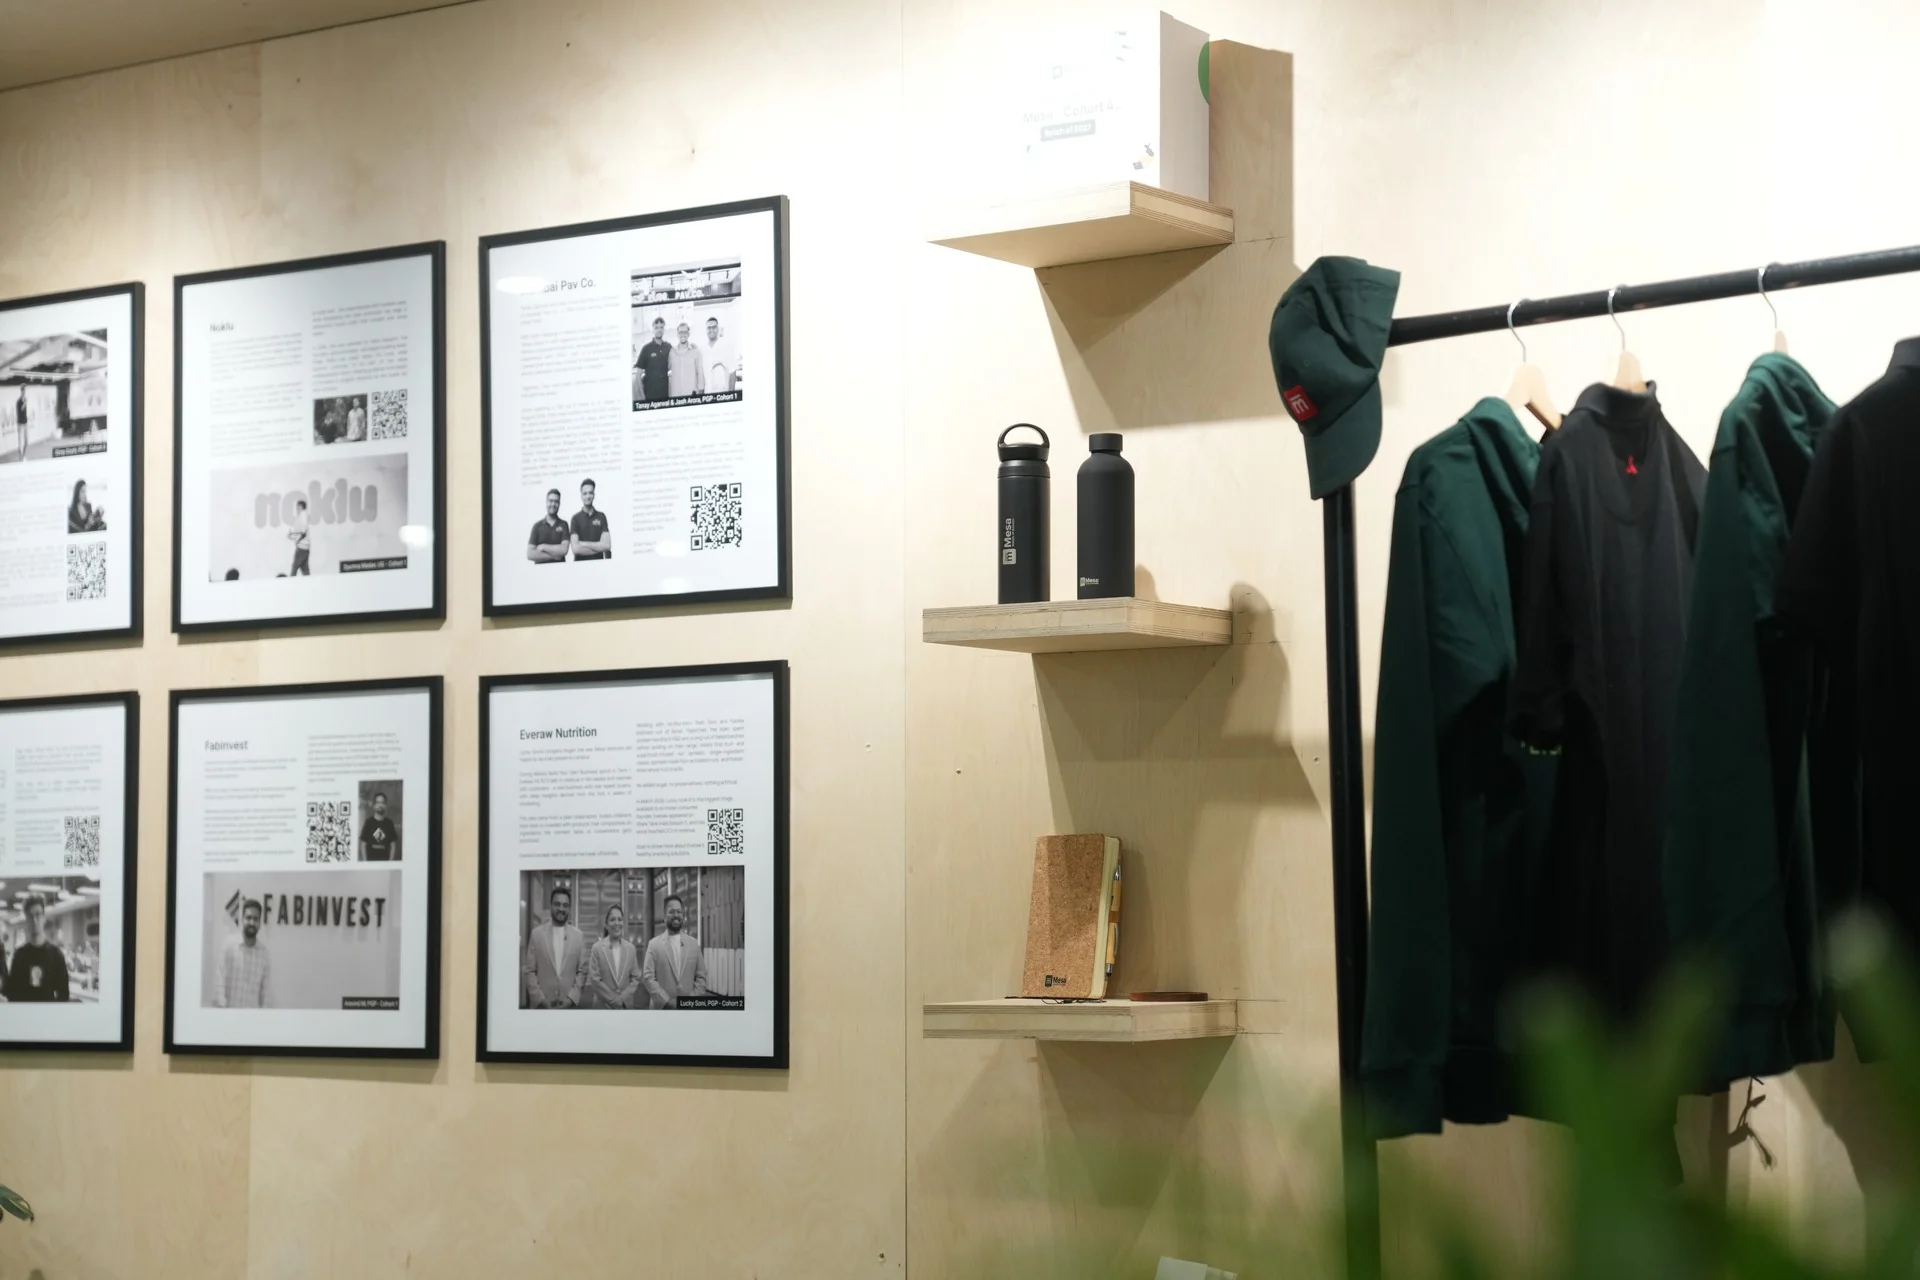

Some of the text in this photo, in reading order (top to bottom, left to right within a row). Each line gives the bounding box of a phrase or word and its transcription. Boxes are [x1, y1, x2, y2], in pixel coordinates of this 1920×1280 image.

[560, 280, 578, 291] Pav
[580, 277, 596, 289] Co.
[717, 393, 734, 401] Cohort
[254, 478, 378, 529] noklu
[1004, 518, 1012, 548] Mesa
[520, 726, 597, 741] Everaw Nutrition
[205, 740, 248, 751] Fabinvest
[263, 893, 386, 927] FABINVEST
[1053, 976, 1067, 984] Mesa
[680, 999, 694, 1008] Lucky
[722, 999, 739, 1007] Cohort
[739, 999, 743, 1007] 2
